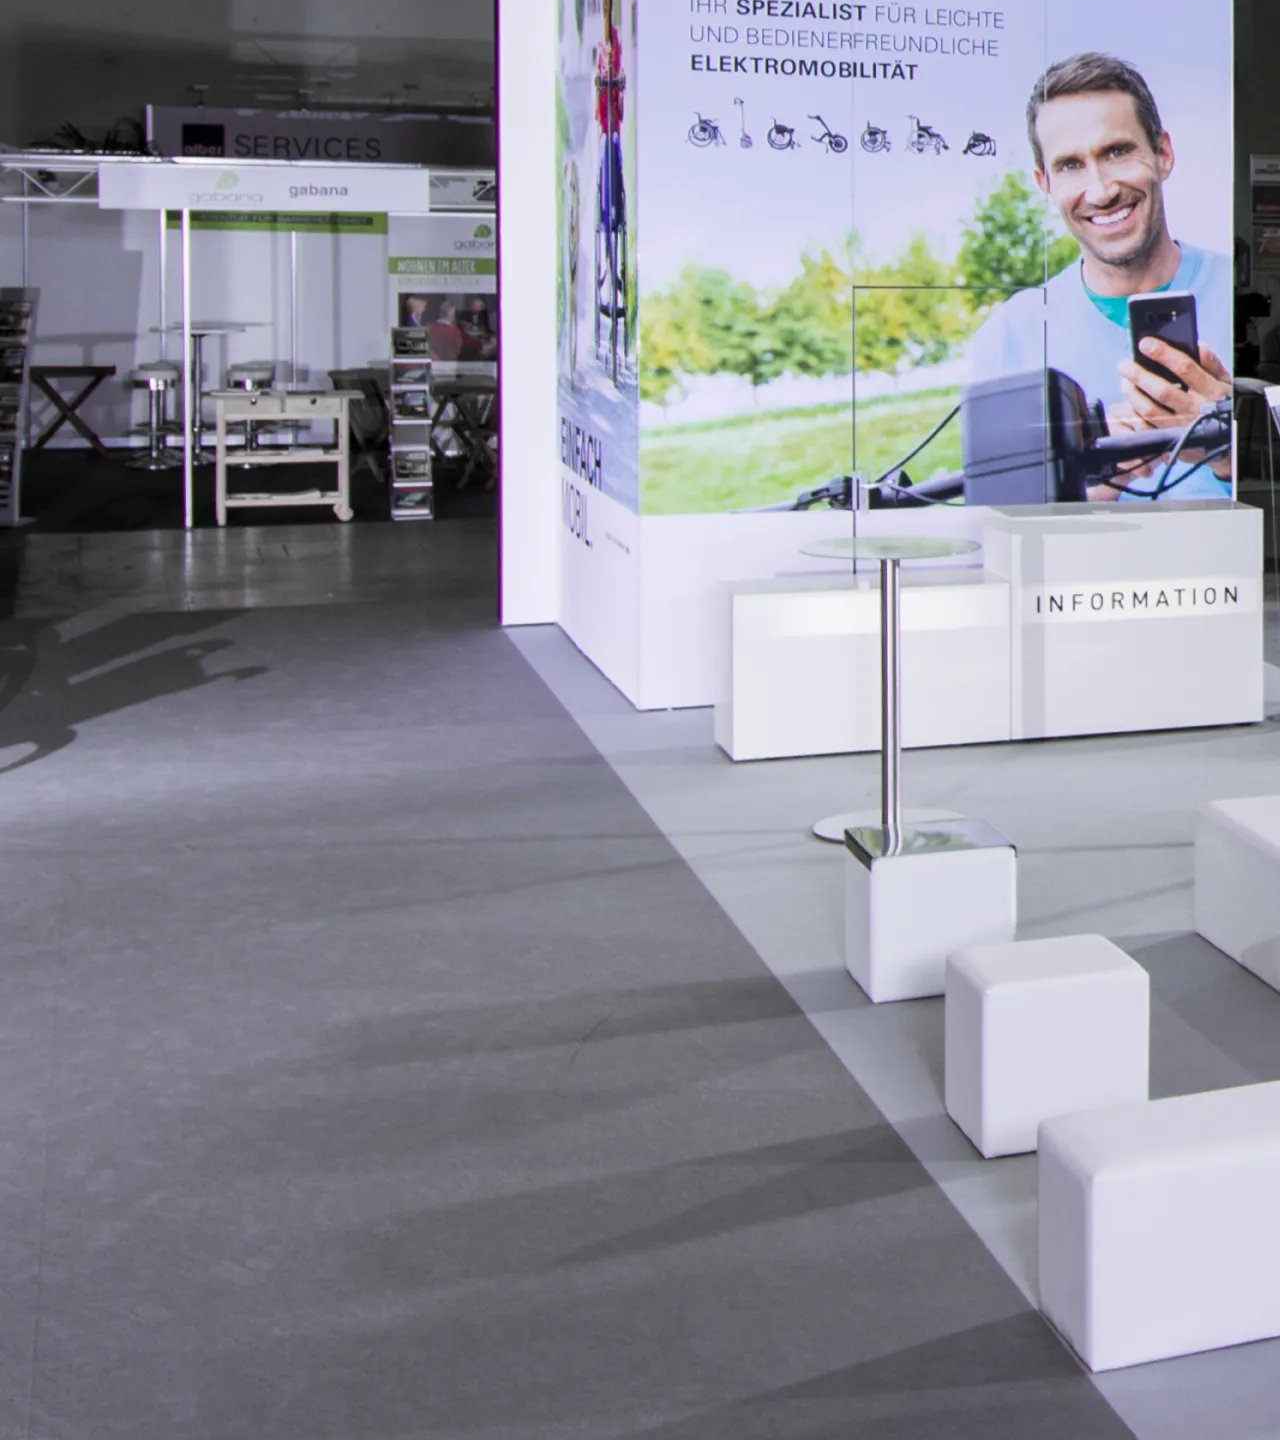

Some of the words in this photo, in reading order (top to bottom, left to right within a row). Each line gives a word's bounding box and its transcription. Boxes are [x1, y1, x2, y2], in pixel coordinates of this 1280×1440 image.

[875, 2, 916, 24] FÜR
[925, 8, 1005, 29] LEICHTE
[690, 25, 739, 44] UND
[746, 28, 999, 57] BEDIENERFREUNDLICHE
[691, 54, 918, 80] ELEKTROMOBILITÄT
[235, 134, 382, 160] SERVICES
[289, 183, 349, 199] gabana
[561, 416, 603, 492] EINFACH
[1035, 586, 1239, 614] INFORMATION
